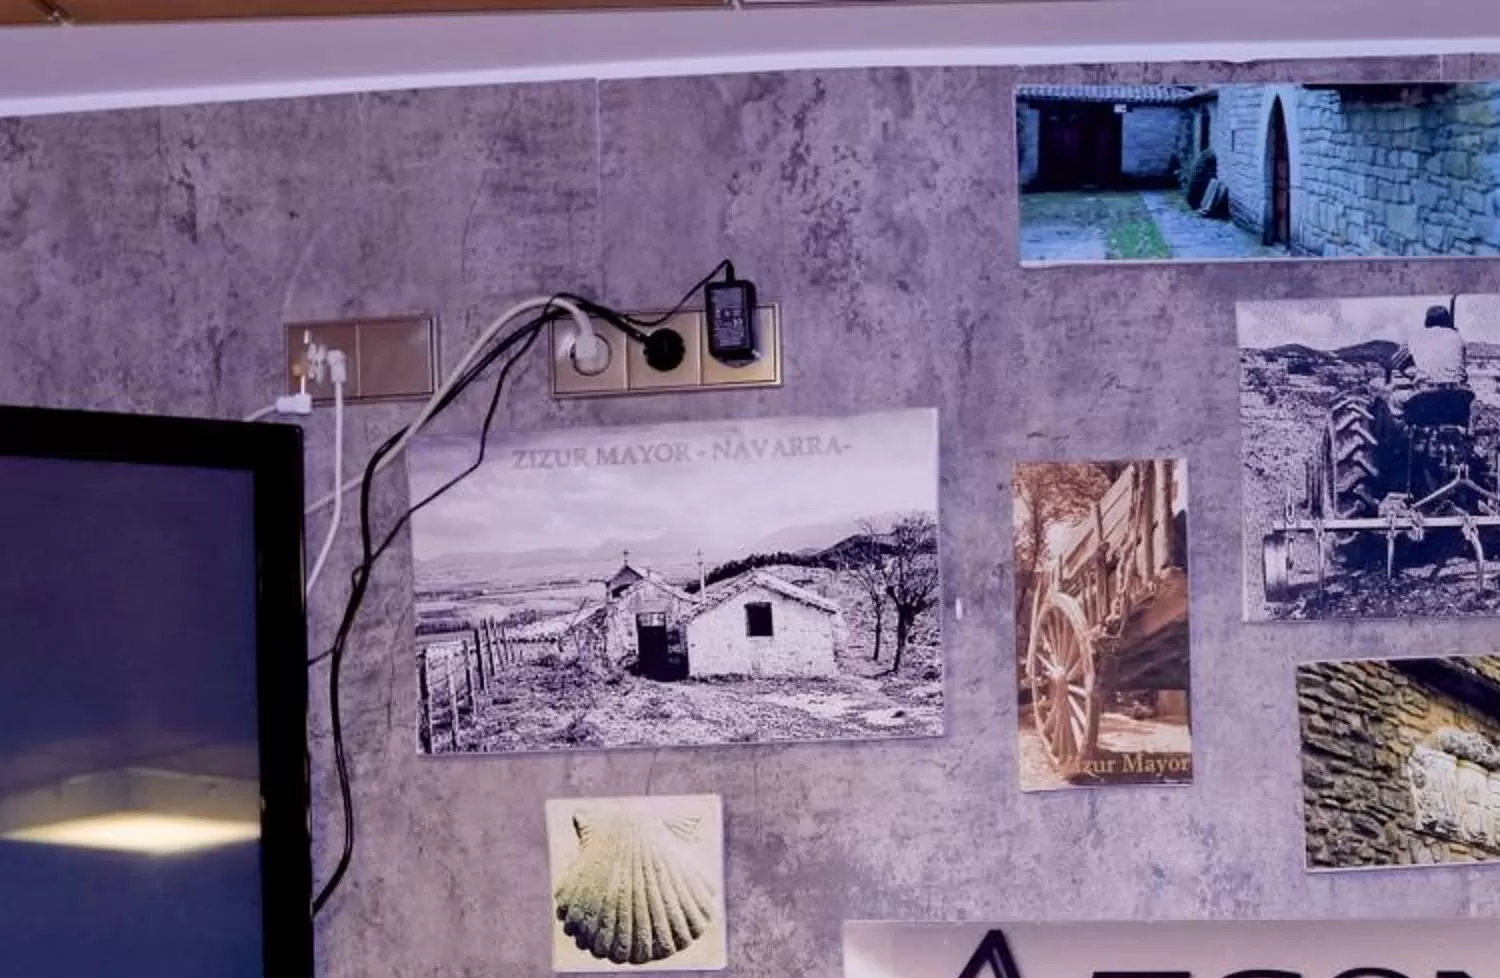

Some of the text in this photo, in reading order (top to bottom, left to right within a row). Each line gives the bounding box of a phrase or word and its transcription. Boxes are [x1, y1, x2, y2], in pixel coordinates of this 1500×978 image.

[511, 447, 592, 470] ZIZUR
[596, 442, 691, 467] MAYOR
[1122, 754, 1191, 775] Mayor
